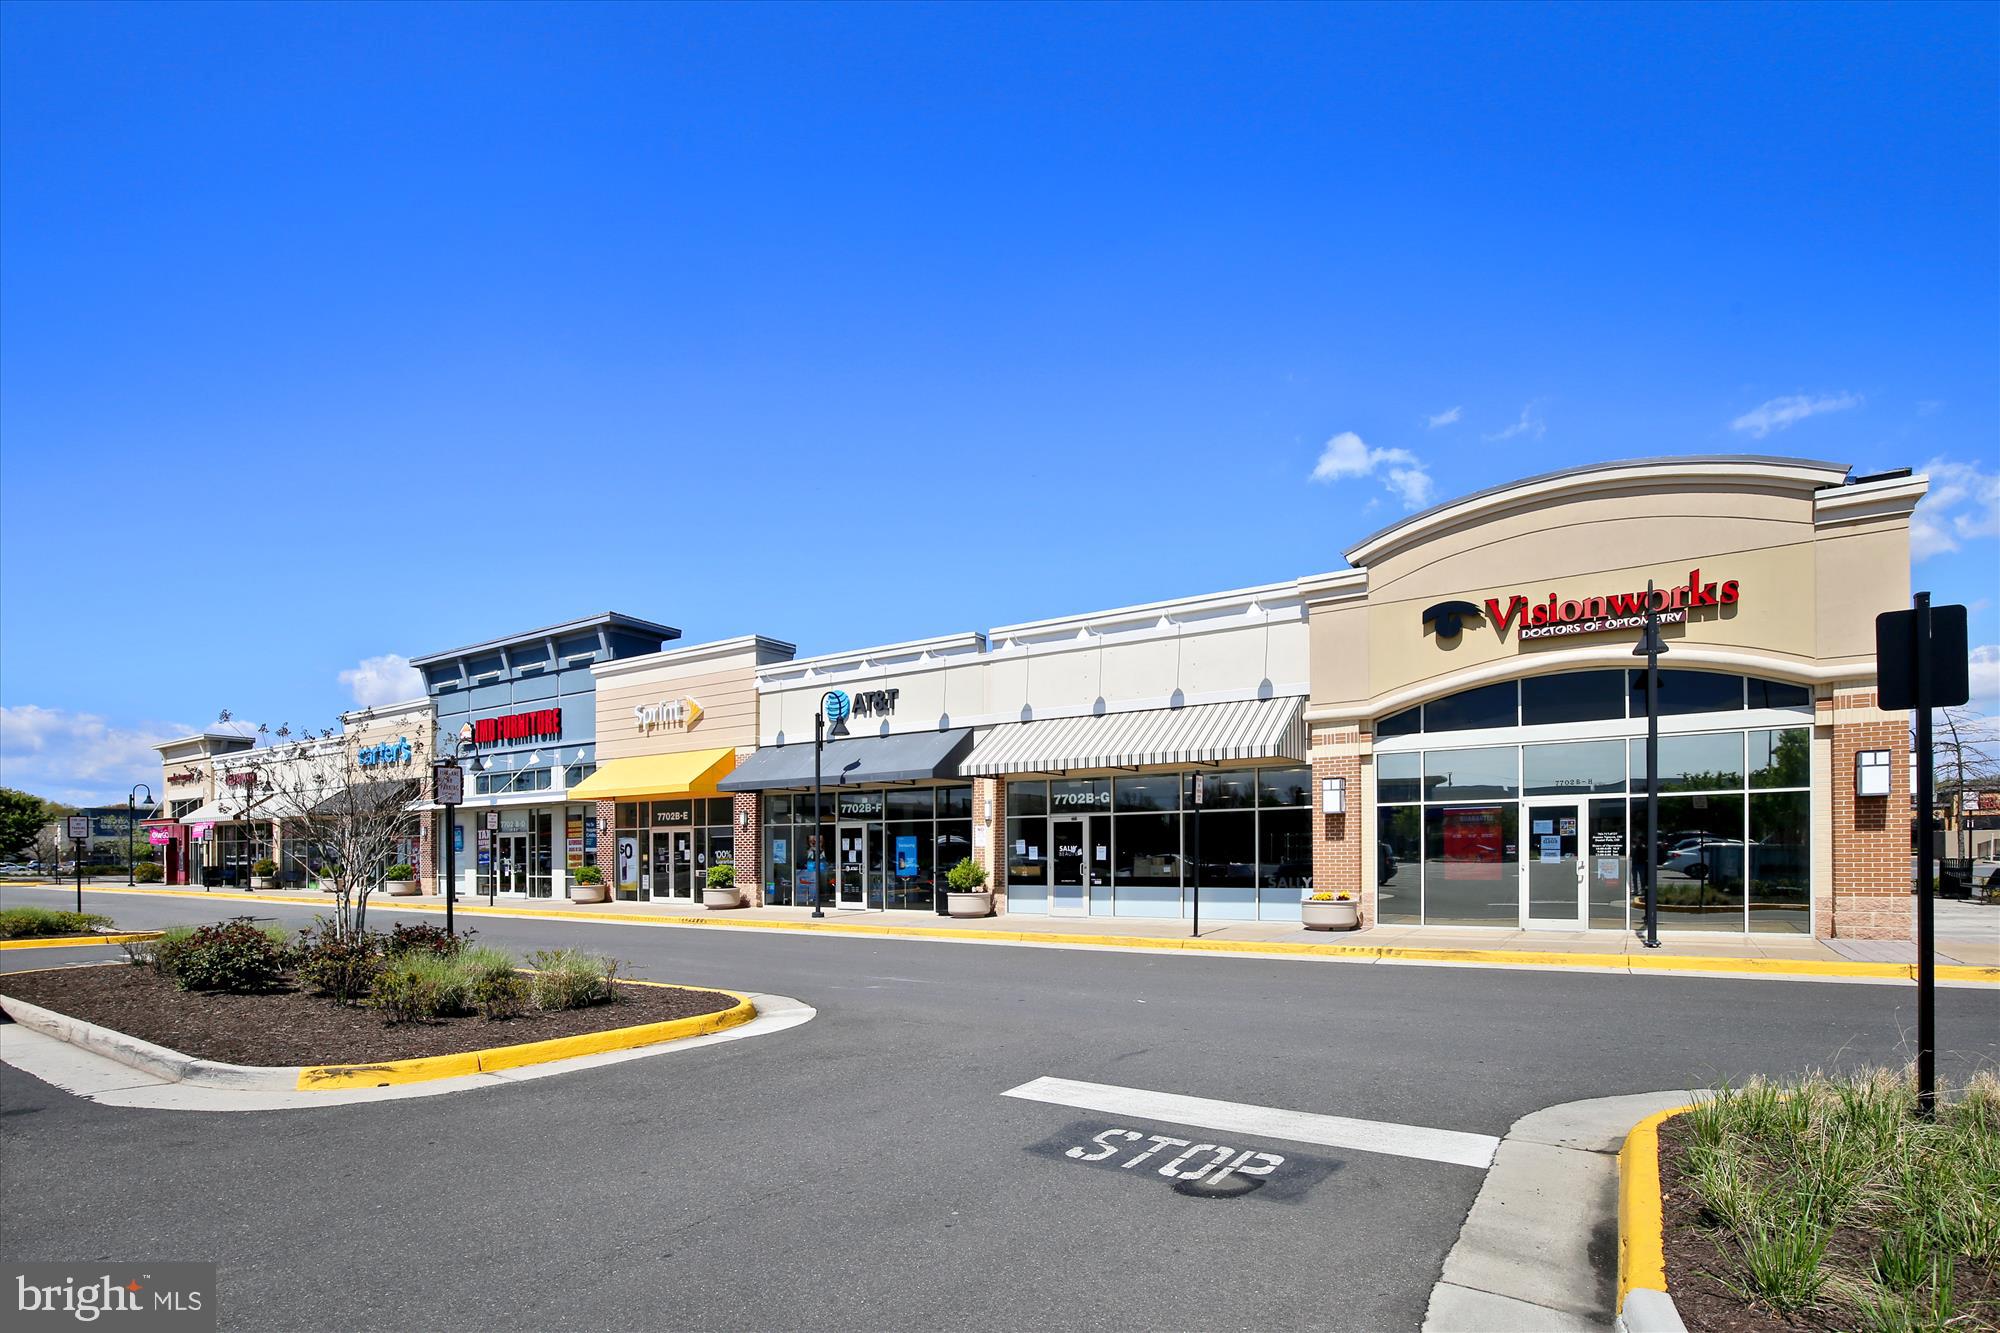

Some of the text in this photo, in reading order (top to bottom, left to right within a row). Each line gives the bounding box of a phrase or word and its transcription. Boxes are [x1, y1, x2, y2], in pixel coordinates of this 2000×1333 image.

[1485, 568, 1739, 630] Visionworks
[1521, 623, 1581, 639] DOCTORS
[1584, 620, 1602, 632] OF
[852, 689, 899, 713] AT&T
[498, 708, 561, 740] FURNITURE
[635, 700, 682, 730] Sprint
[841, 803, 882, 814] 7702B-F
[1054, 792, 1110, 804] 7702B-G
[620, 843, 632, 859] $0
[1268, 876, 1313, 888] SALLY
[1065, 1129, 1286, 1186] STOP
